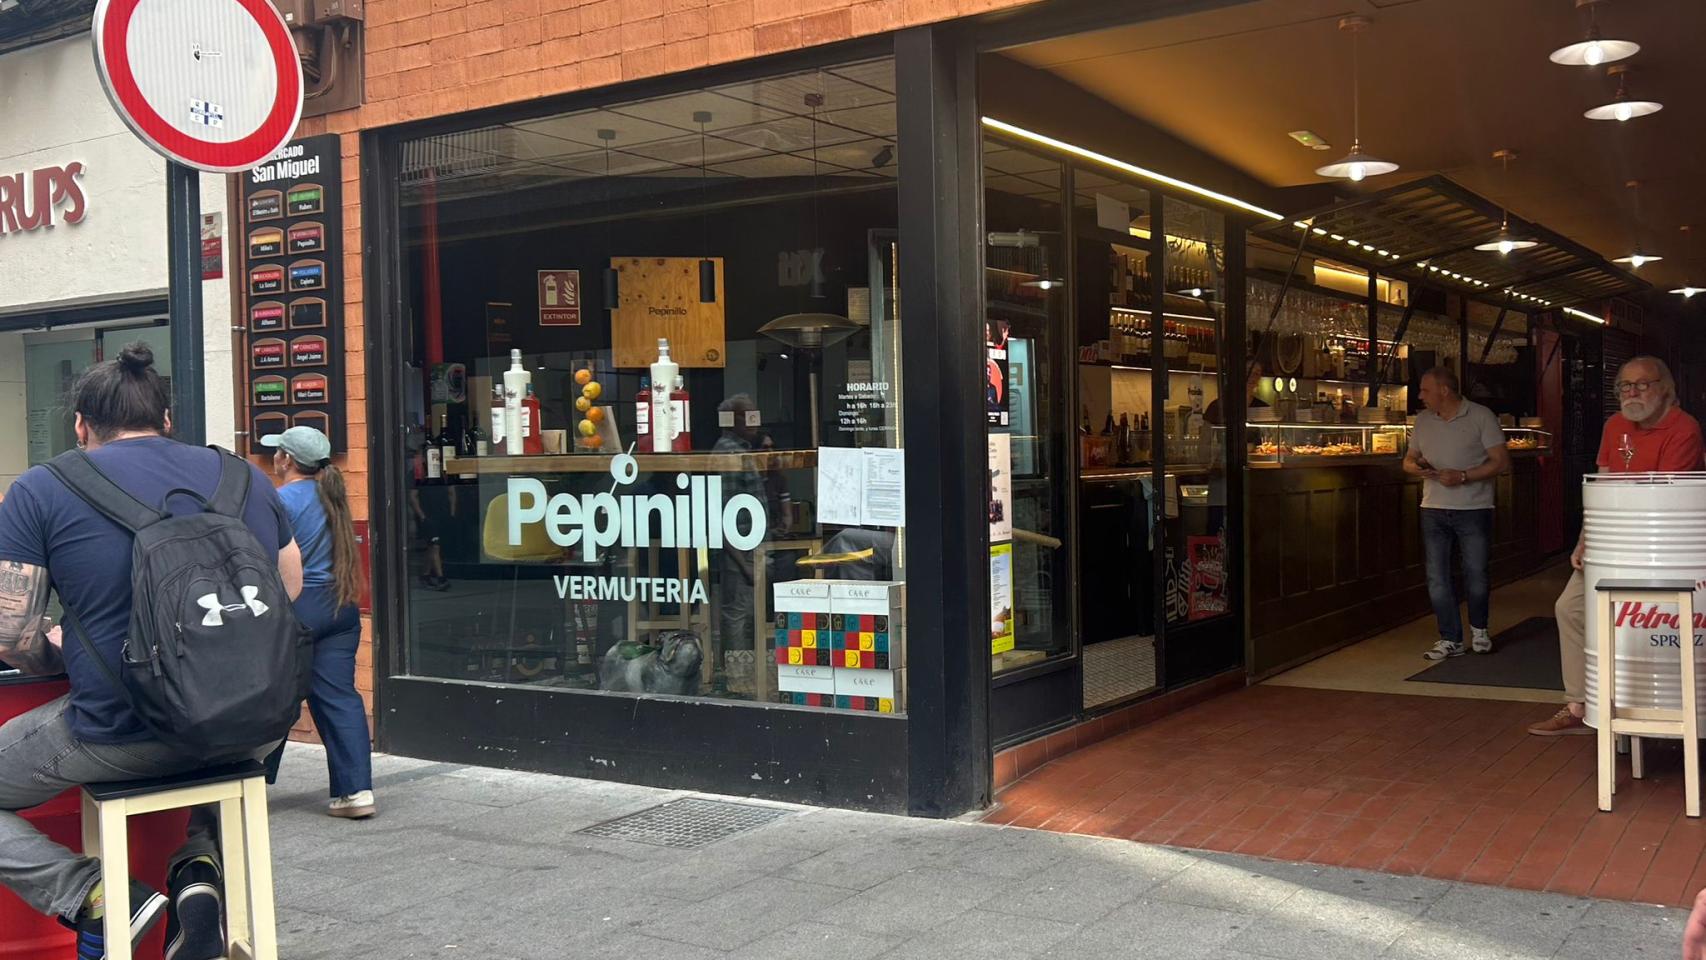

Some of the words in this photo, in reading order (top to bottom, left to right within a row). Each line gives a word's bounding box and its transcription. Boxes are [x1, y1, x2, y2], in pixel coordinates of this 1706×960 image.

[252, 165, 275, 183] San
[276, 155, 320, 179] Miguel
[648, 305, 688, 317] Pepinillo
[847, 382, 889, 391] HORARIO
[507, 453, 767, 562] Pepinillo
[553, 575, 709, 604] VERMUTERIA
[1650, 634, 1704, 648] SPRZ
